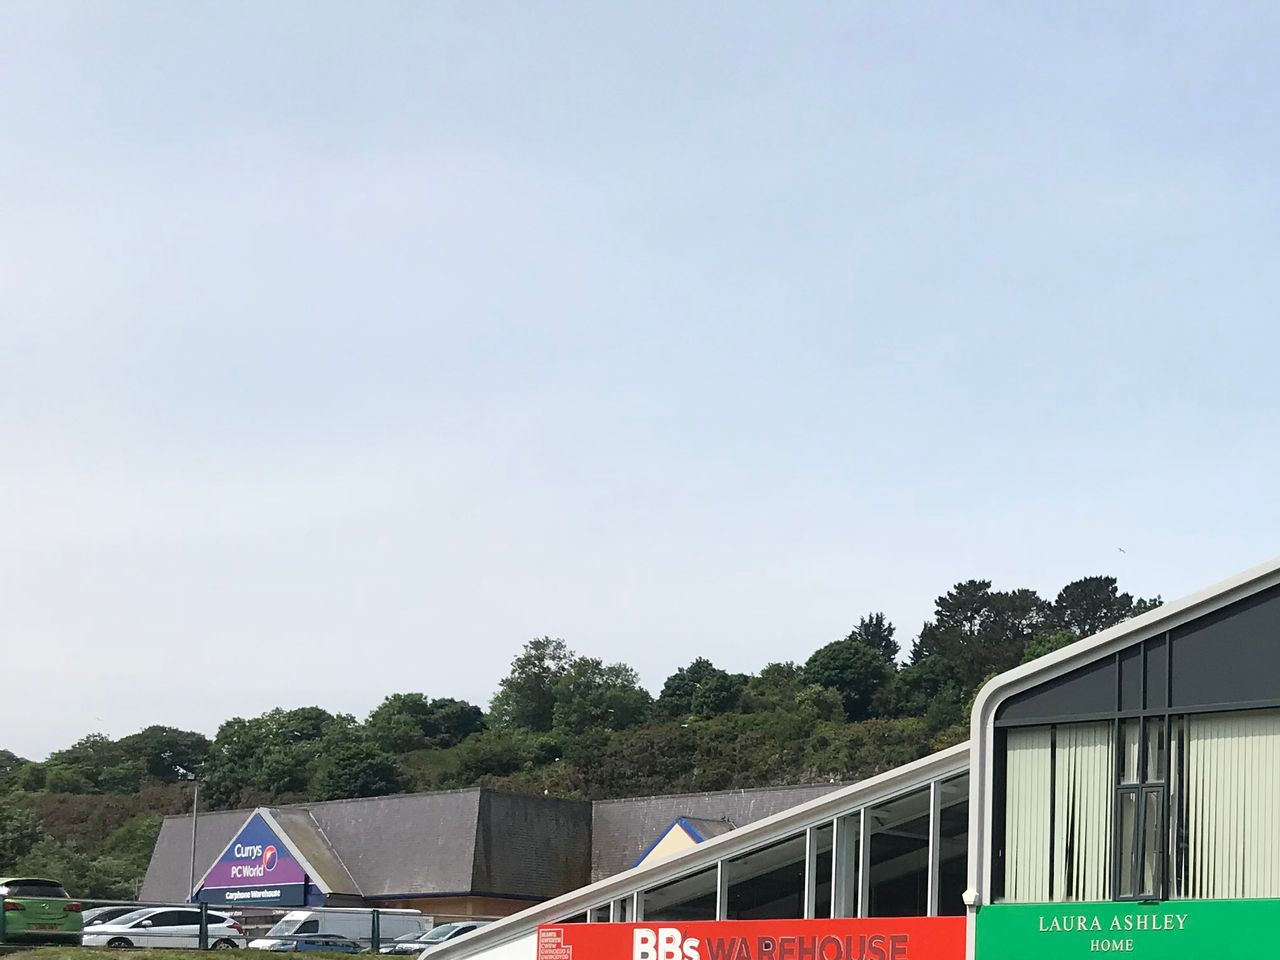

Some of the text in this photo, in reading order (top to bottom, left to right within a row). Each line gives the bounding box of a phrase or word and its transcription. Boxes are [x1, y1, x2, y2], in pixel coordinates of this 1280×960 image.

[234, 844, 262, 859] Currys
[231, 864, 264, 878] PC World
[225, 891, 250, 900] Carphone
[1039, 914, 1188, 932] LAURA ASHLEY
[1090, 939, 1134, 952] HOME
